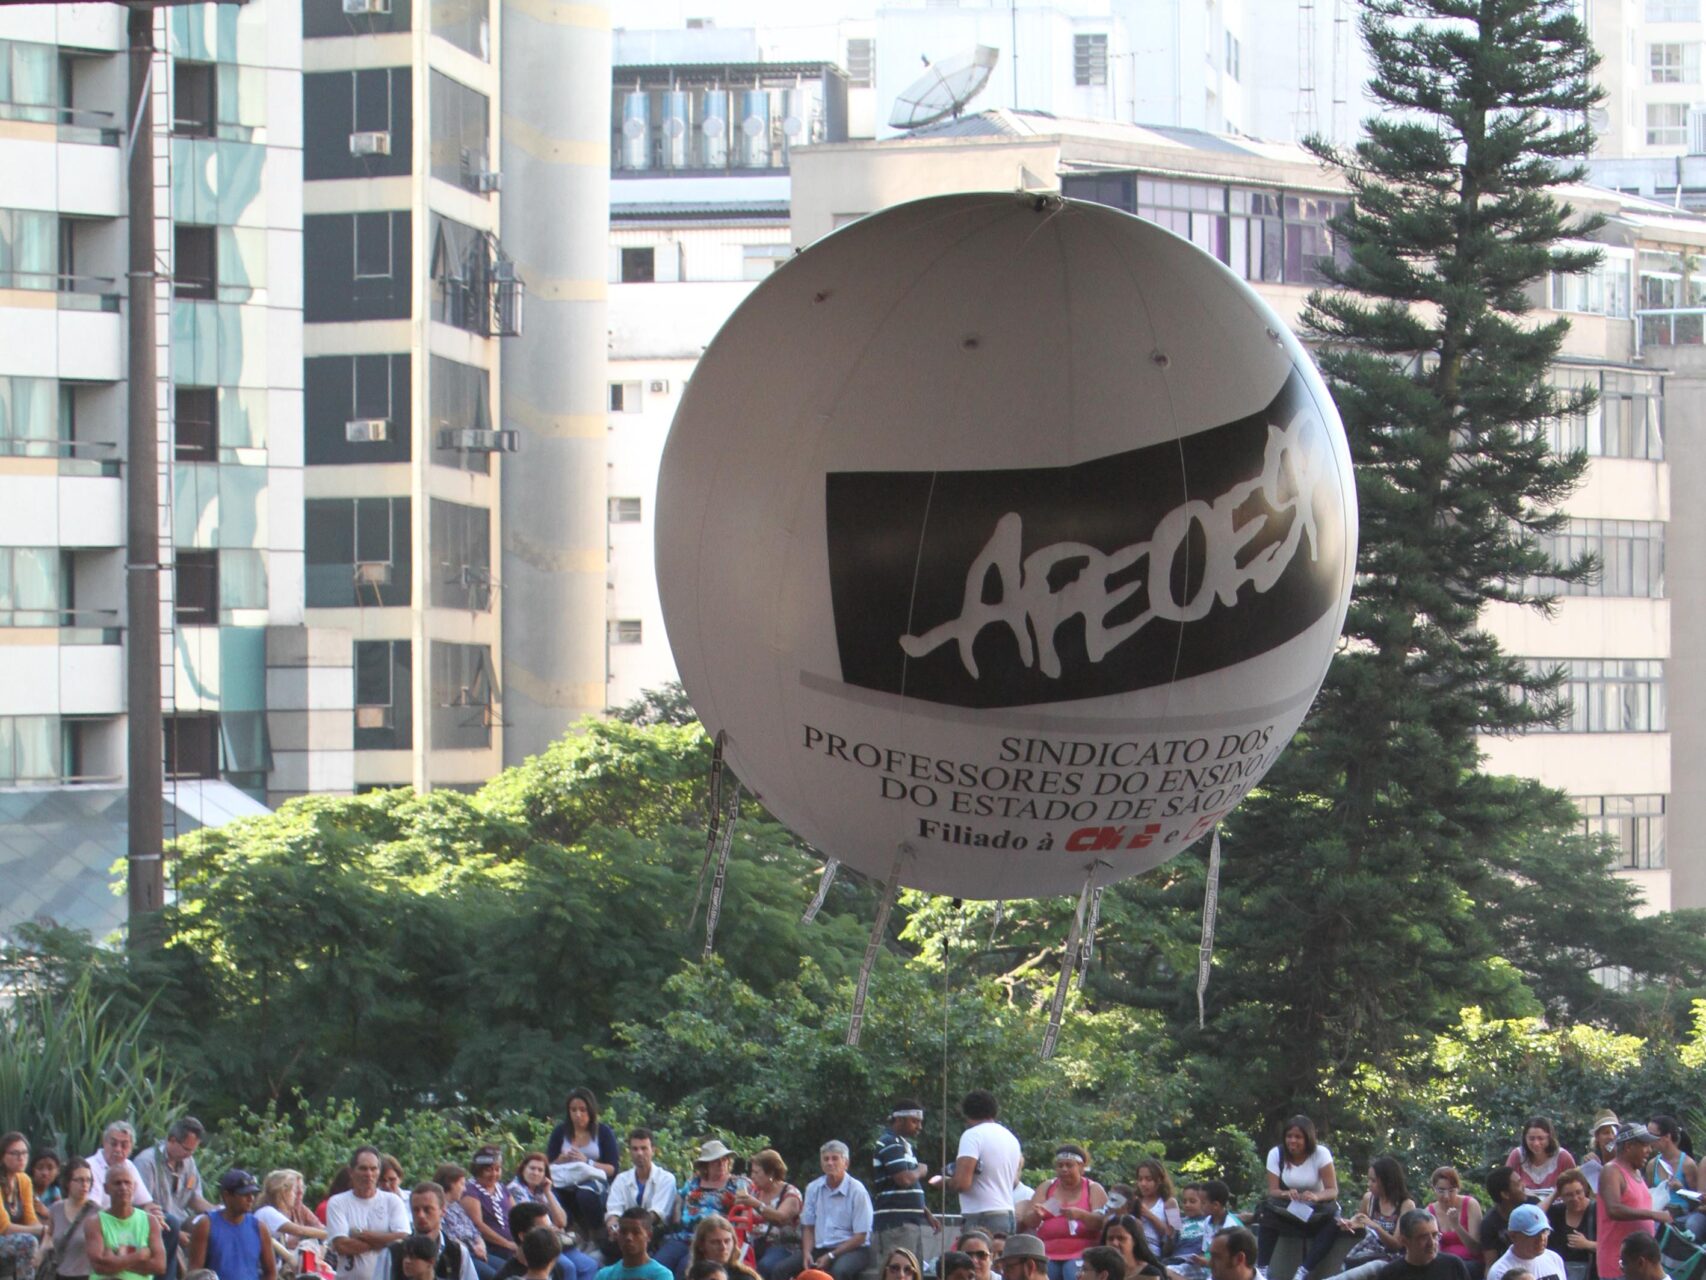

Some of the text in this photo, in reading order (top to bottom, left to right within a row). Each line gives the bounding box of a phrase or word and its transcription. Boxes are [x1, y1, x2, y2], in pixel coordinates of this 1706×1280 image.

[900, 412, 1320, 680] APEOESP
[802, 724, 1083, 795] PROFESSORES
[1093, 771, 1149, 796] DO
[1156, 753, 1264, 793] ENSINO
[999, 737, 1209, 767] SINDICATO
[1216, 725, 1274, 760] DOS
[879, 776, 938, 808] DO
[949, 791, 1098, 822] ESTADO
[1105, 799, 1156, 821] DE
[1161, 789, 1224, 818] SÃO
[918, 818, 1028, 851] Filiado
[1037, 832, 1055, 851] à
[1163, 830, 1179, 843] e
